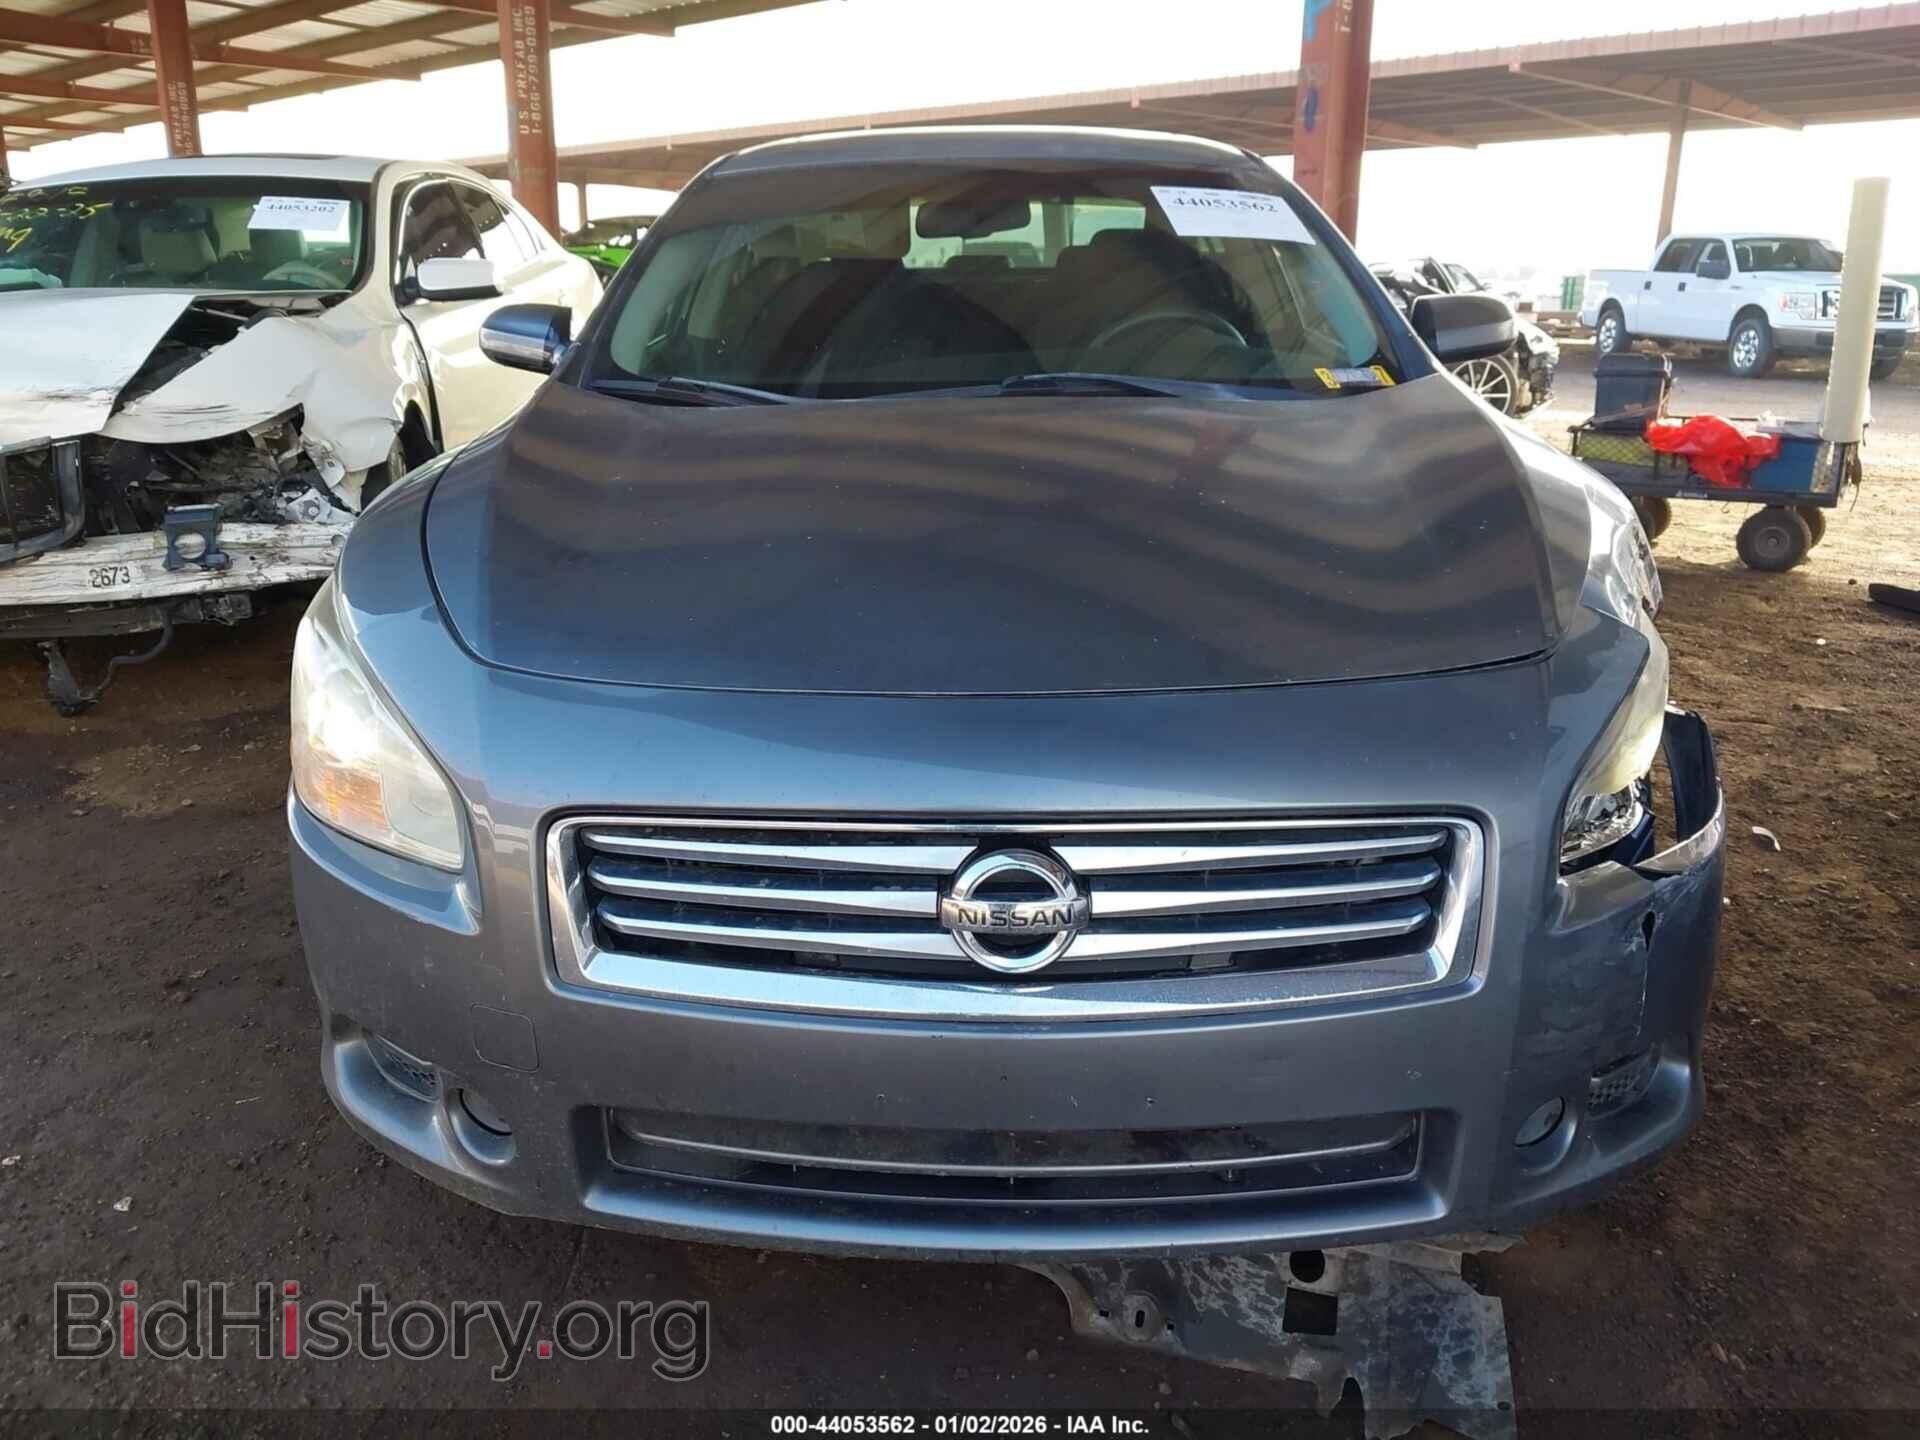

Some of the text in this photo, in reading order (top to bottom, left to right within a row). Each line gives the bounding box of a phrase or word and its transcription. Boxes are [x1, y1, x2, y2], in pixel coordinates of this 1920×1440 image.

[1172, 197, 1279, 214] 44053562
[89, 566, 130, 588] 2673
[957, 908, 1073, 927] NISSAN
